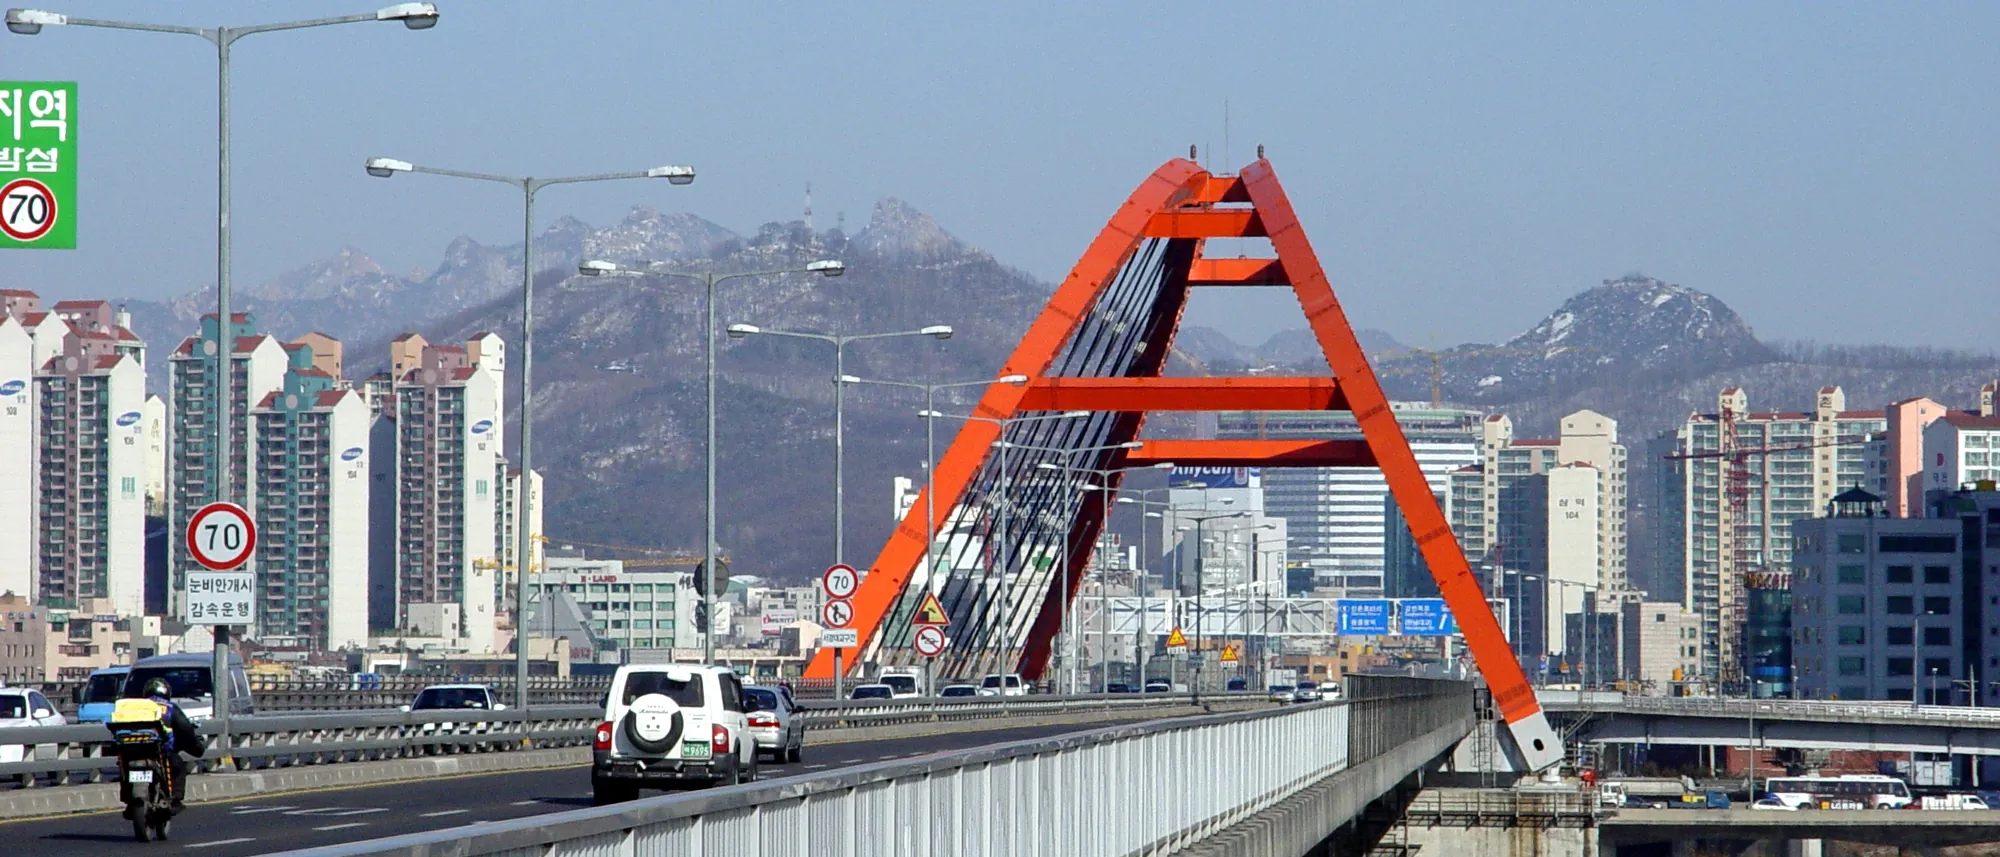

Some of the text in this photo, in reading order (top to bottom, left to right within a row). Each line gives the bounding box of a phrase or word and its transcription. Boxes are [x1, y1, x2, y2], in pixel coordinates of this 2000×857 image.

[0, 88, 67, 142] 지역
[0, 147, 58, 173] 밤섬
[8, 193, 48, 225] 70
[204, 523, 240, 550] 70
[189, 578, 252, 593] 눈비안개시
[832, 576, 849, 590] 70
[191, 602, 249, 618] 감속운행
